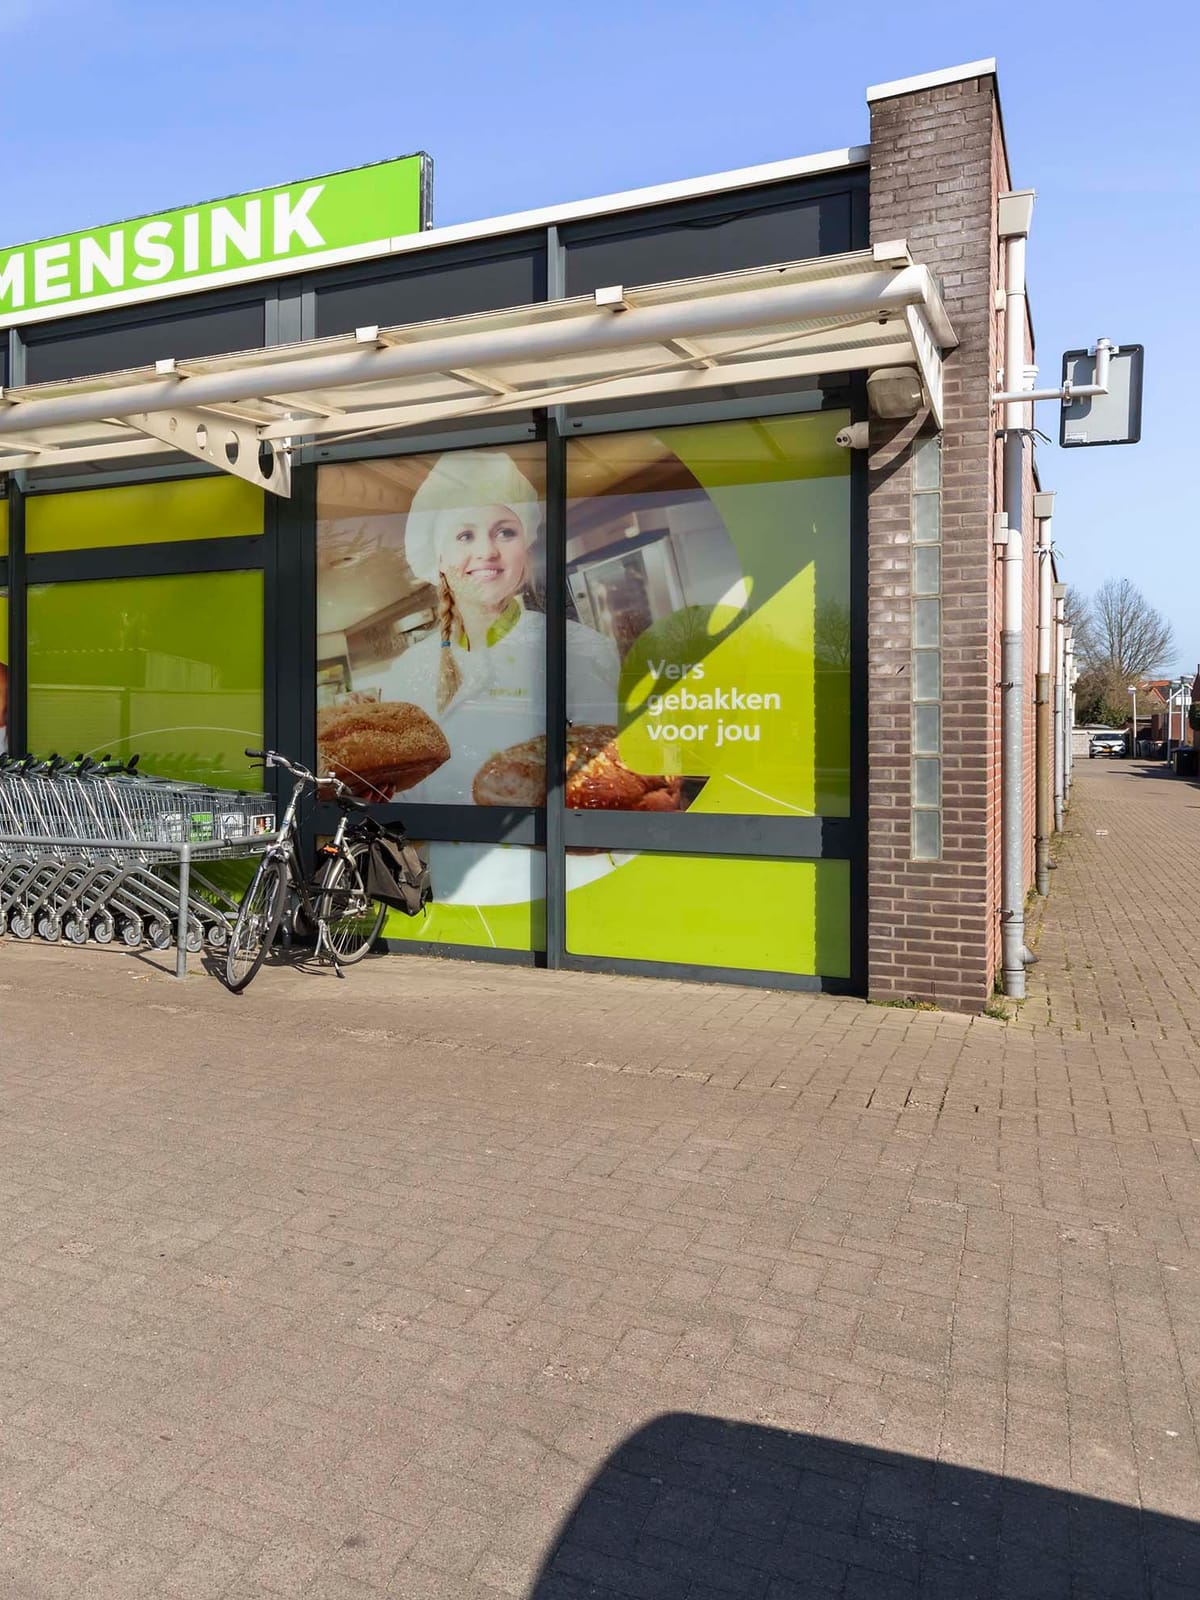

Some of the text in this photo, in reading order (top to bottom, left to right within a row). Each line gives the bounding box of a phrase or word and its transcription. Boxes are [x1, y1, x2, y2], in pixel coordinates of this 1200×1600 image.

[647, 659, 705, 681] Vers
[647, 687, 781, 716] gebakken
[647, 719, 760, 747] voor jou
